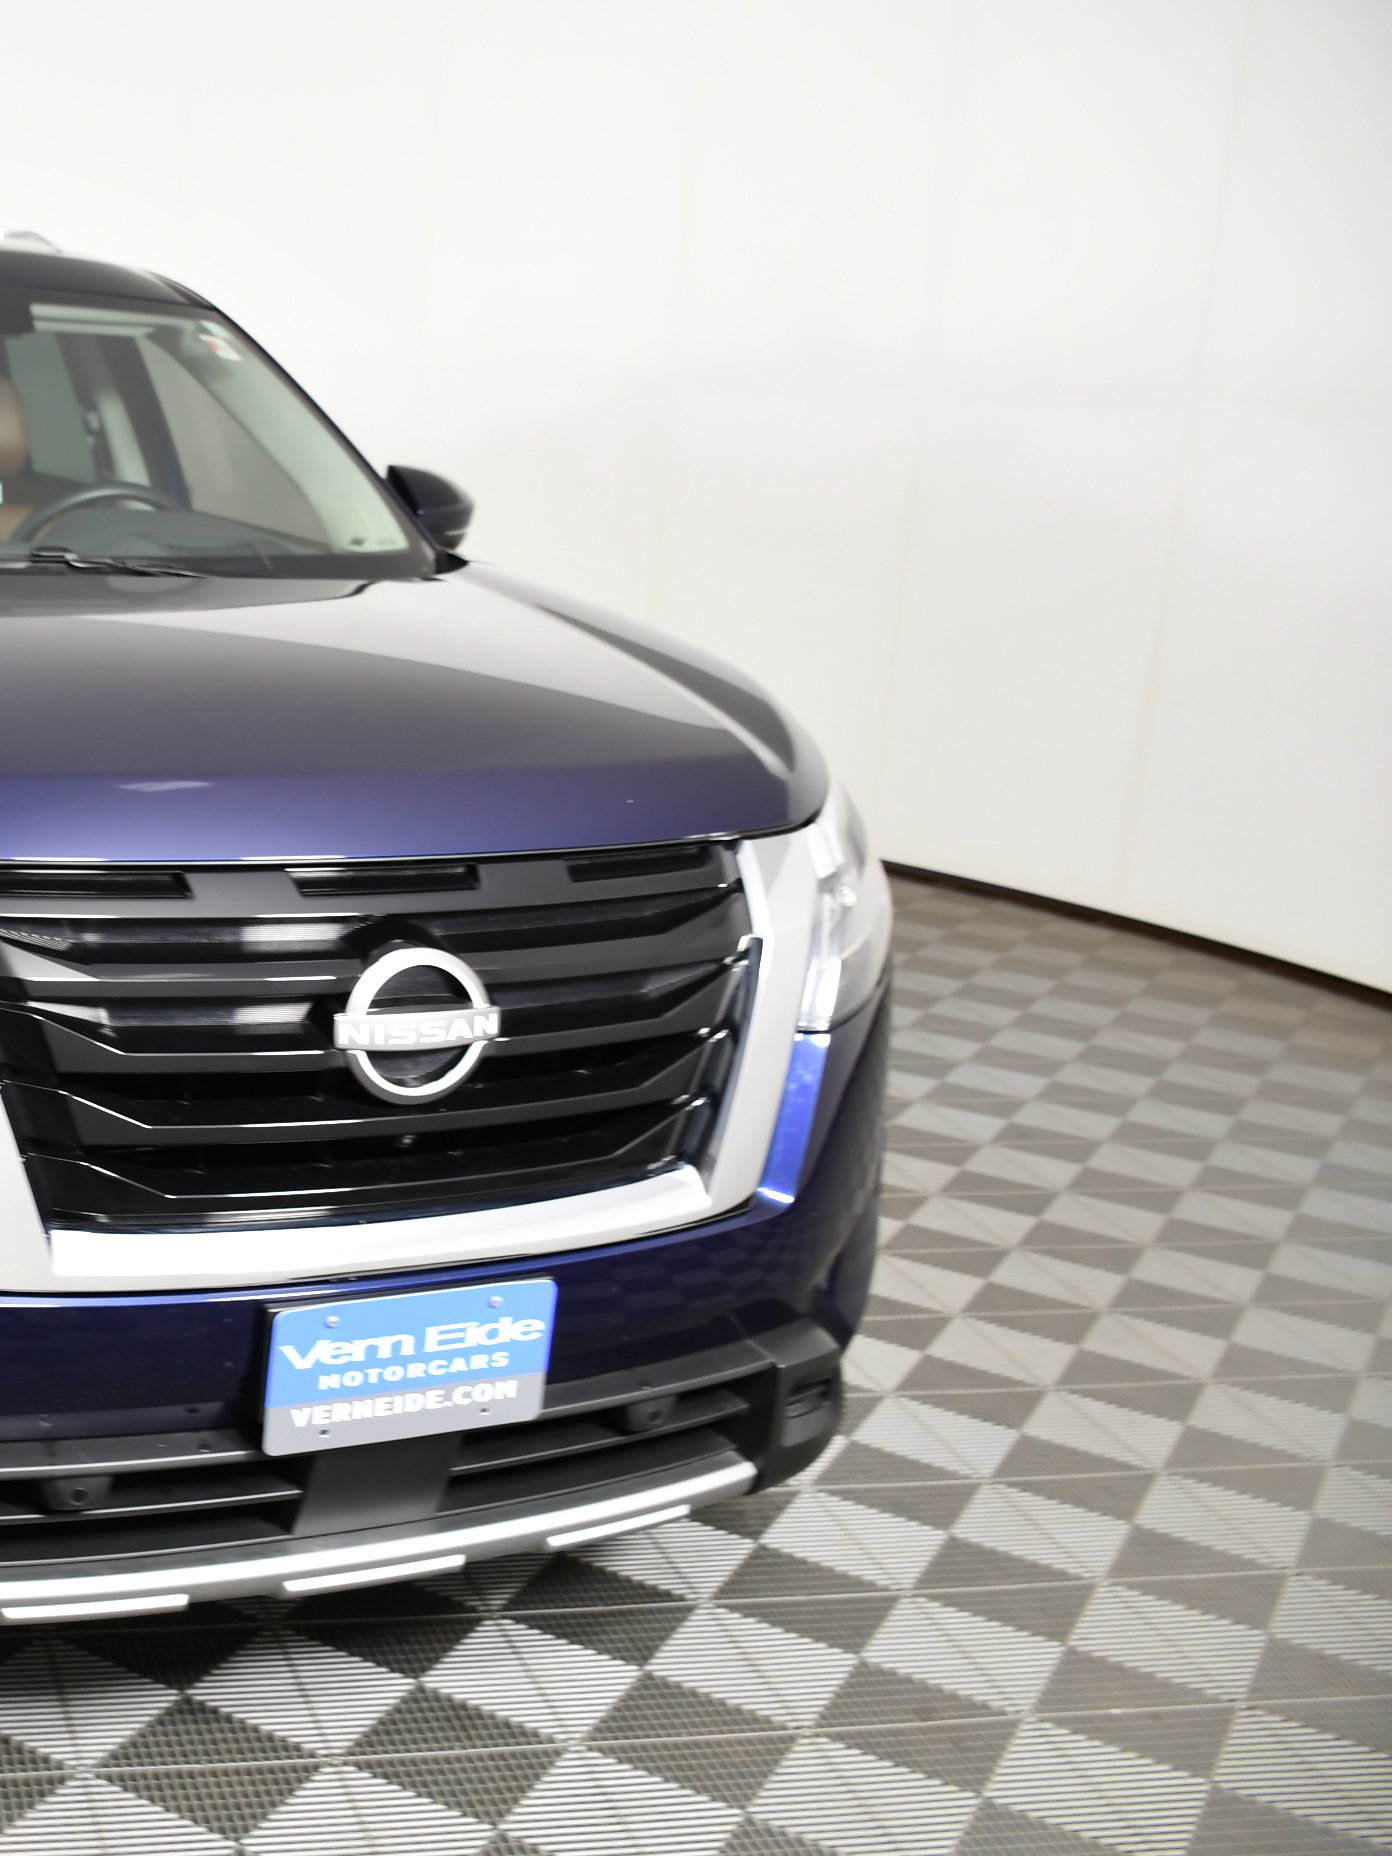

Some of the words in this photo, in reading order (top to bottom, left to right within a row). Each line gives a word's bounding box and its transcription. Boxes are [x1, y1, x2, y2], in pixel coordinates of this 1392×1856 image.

[338, 1013, 498, 1045] NISSAN
[279, 1333, 416, 1370] Vern
[423, 1316, 546, 1353] Eide
[318, 1352, 510, 1390] MOTORCARS
[290, 1379, 518, 1428] VERNEIDE.COM
